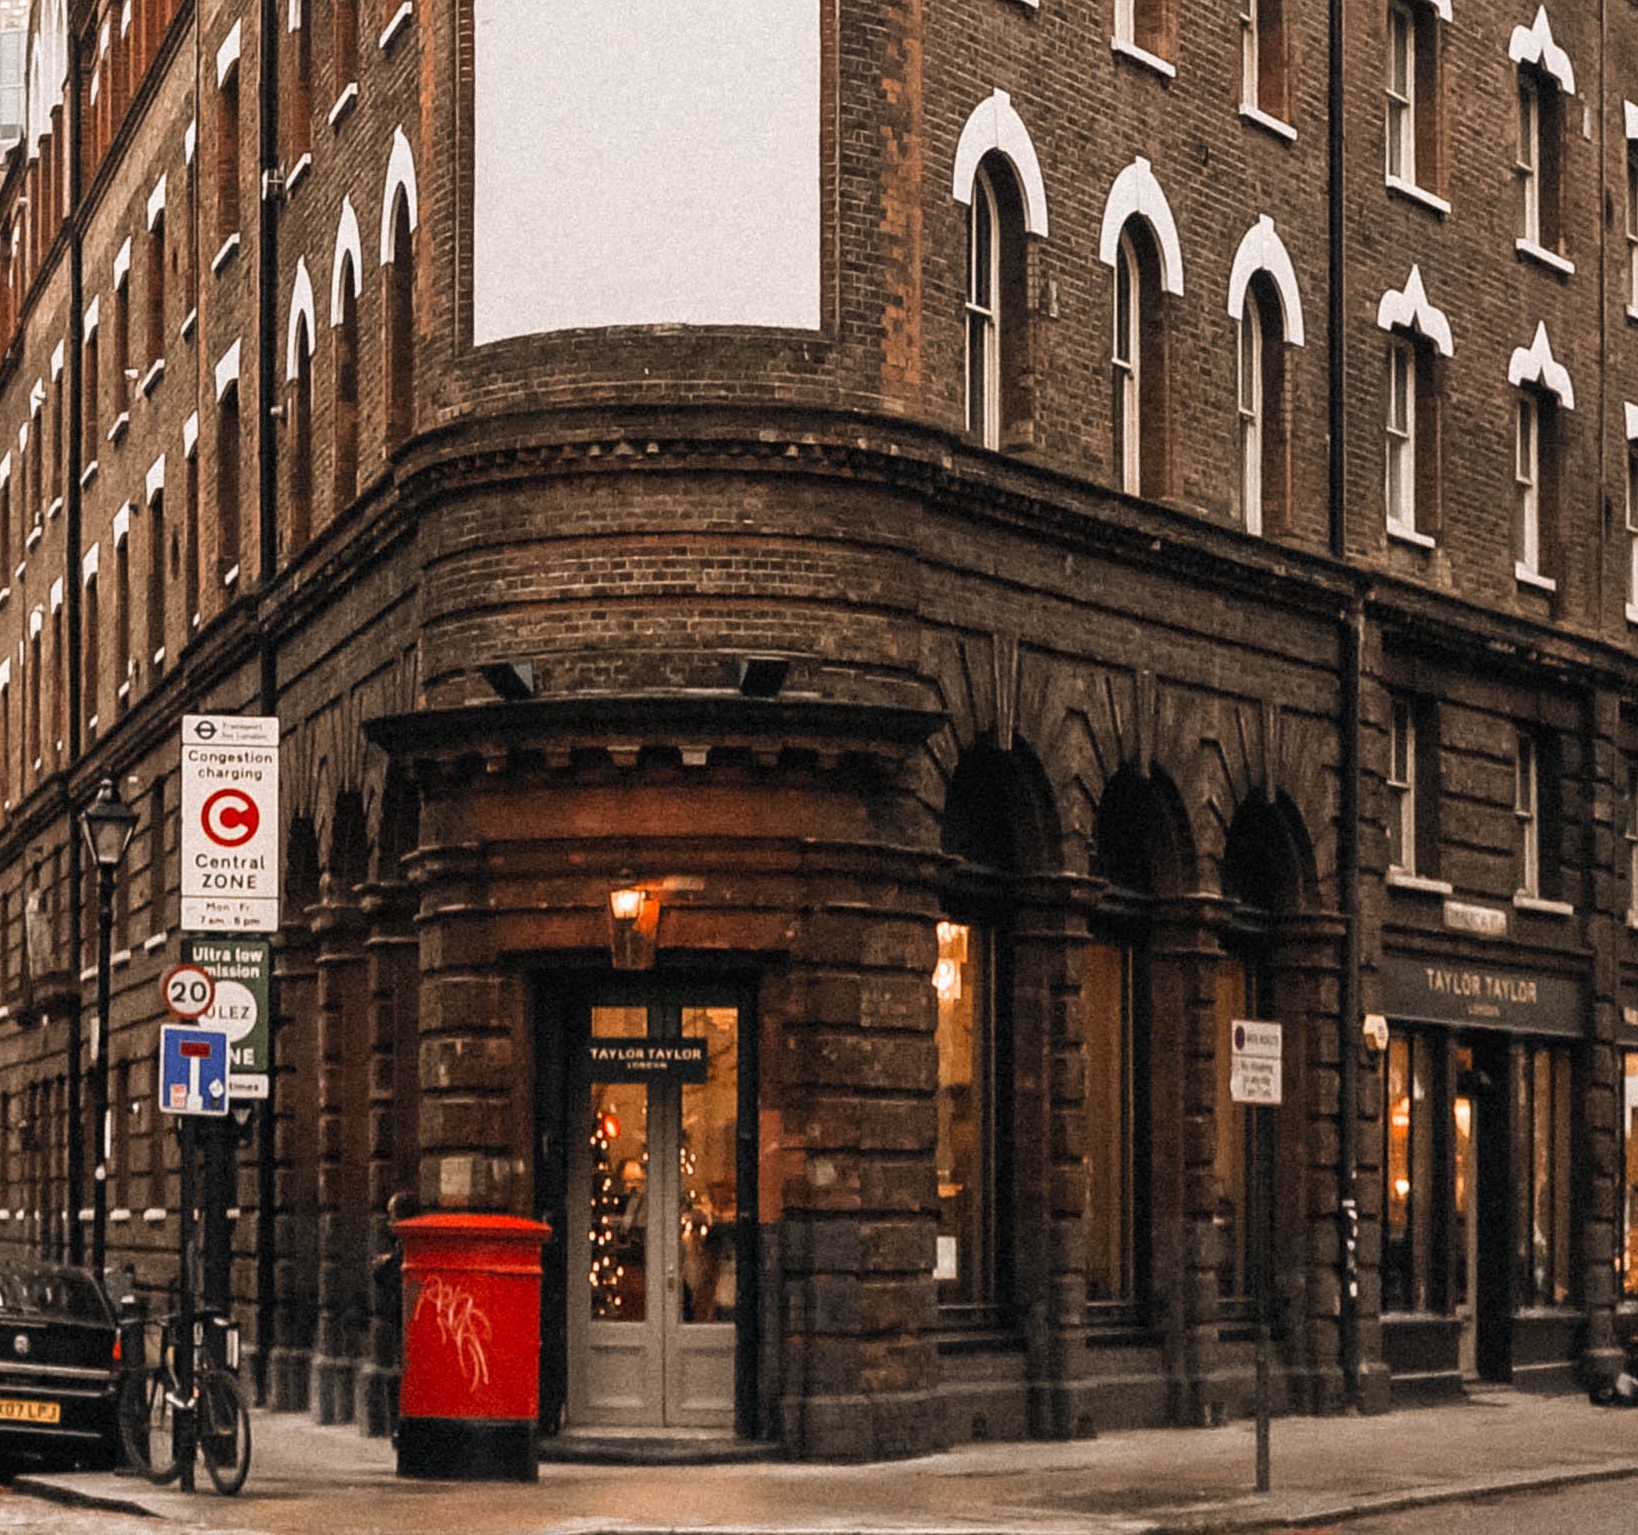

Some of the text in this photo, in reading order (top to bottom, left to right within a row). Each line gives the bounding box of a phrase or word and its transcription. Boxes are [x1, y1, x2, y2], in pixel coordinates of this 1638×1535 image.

[188, 750, 273, 765] Congestion
[198, 766, 263, 781] charging
[195, 853, 265, 870] Central
[202, 873, 257, 890] ZONE
[192, 946, 264, 963] Ultra low
[203, 963, 261, 979] mission
[171, 980, 208, 1004] 20
[1426, 967, 1538, 1004] TAYLOR TAYLOR
[589, 1047, 702, 1061] TAYLOR TAYLOR
